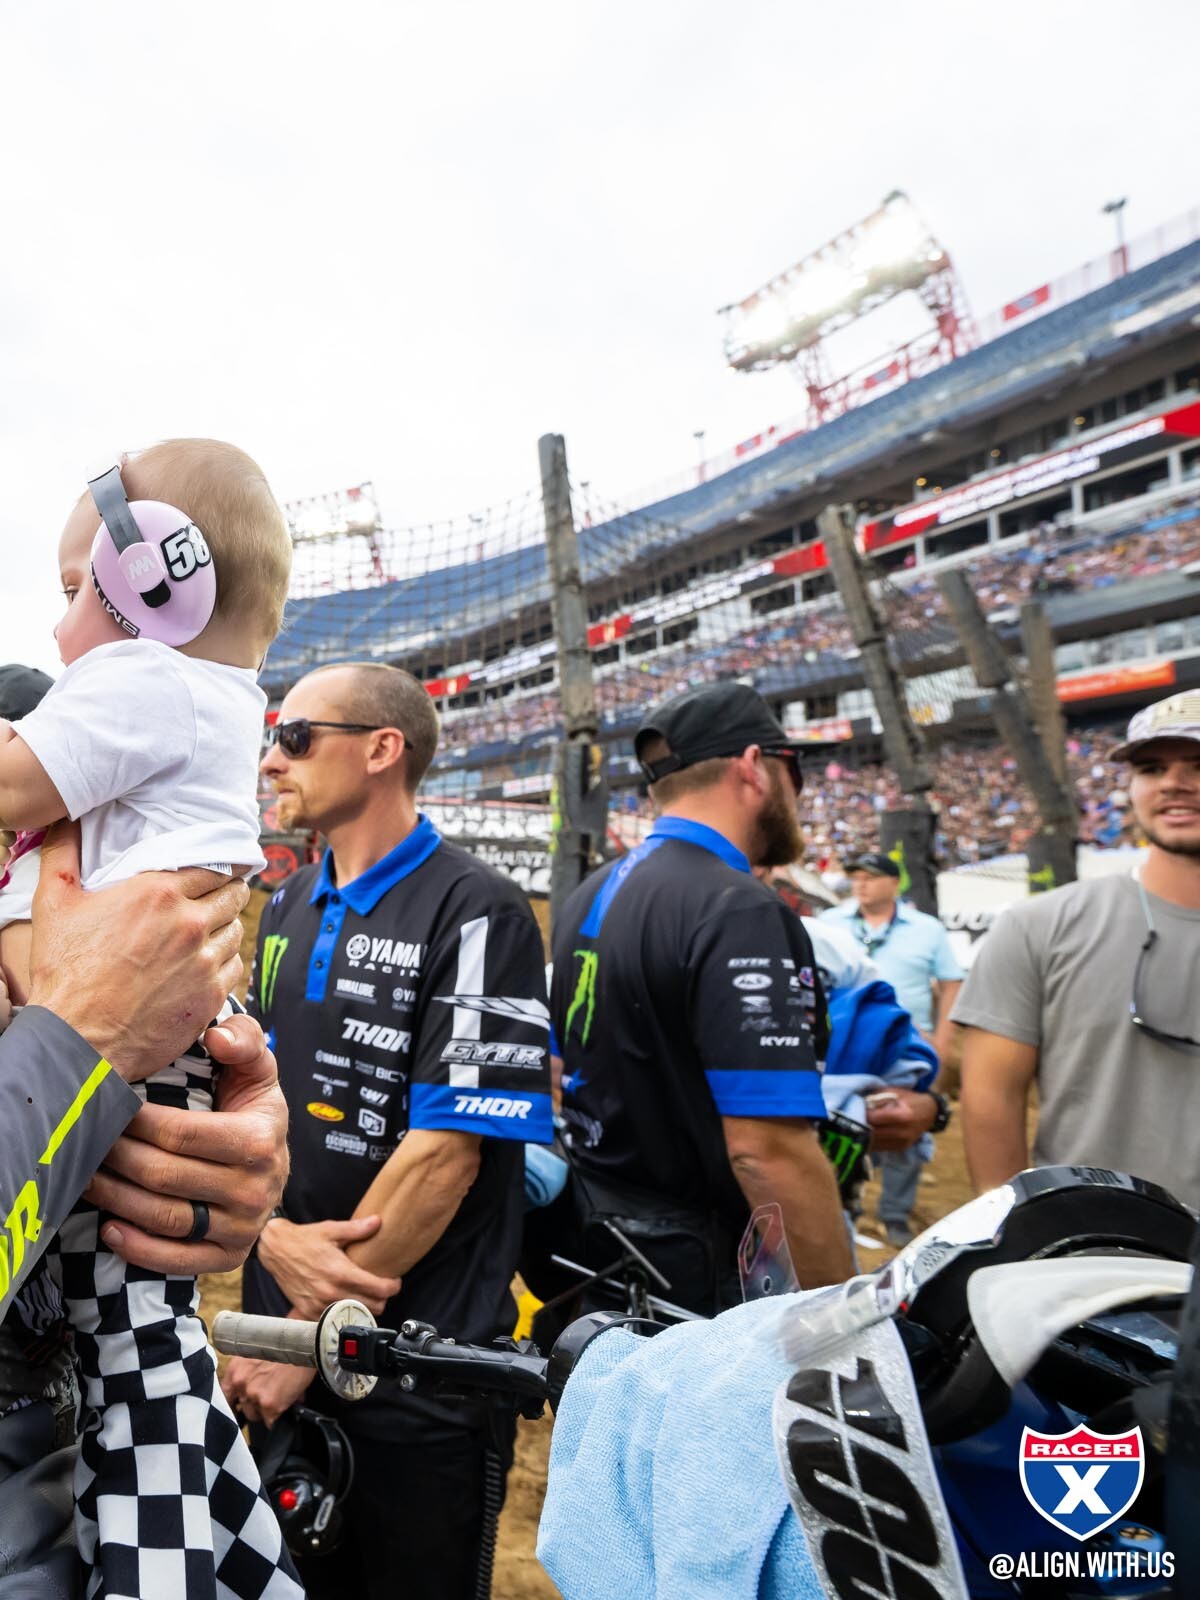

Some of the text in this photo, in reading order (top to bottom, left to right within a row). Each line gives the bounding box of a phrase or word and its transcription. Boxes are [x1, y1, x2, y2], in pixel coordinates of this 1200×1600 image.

[370, 936, 428, 969] YAMA
[341, 1017, 413, 1054] THOR
[441, 1040, 546, 1066] GYTR
[454, 1095, 533, 1120] THOR
